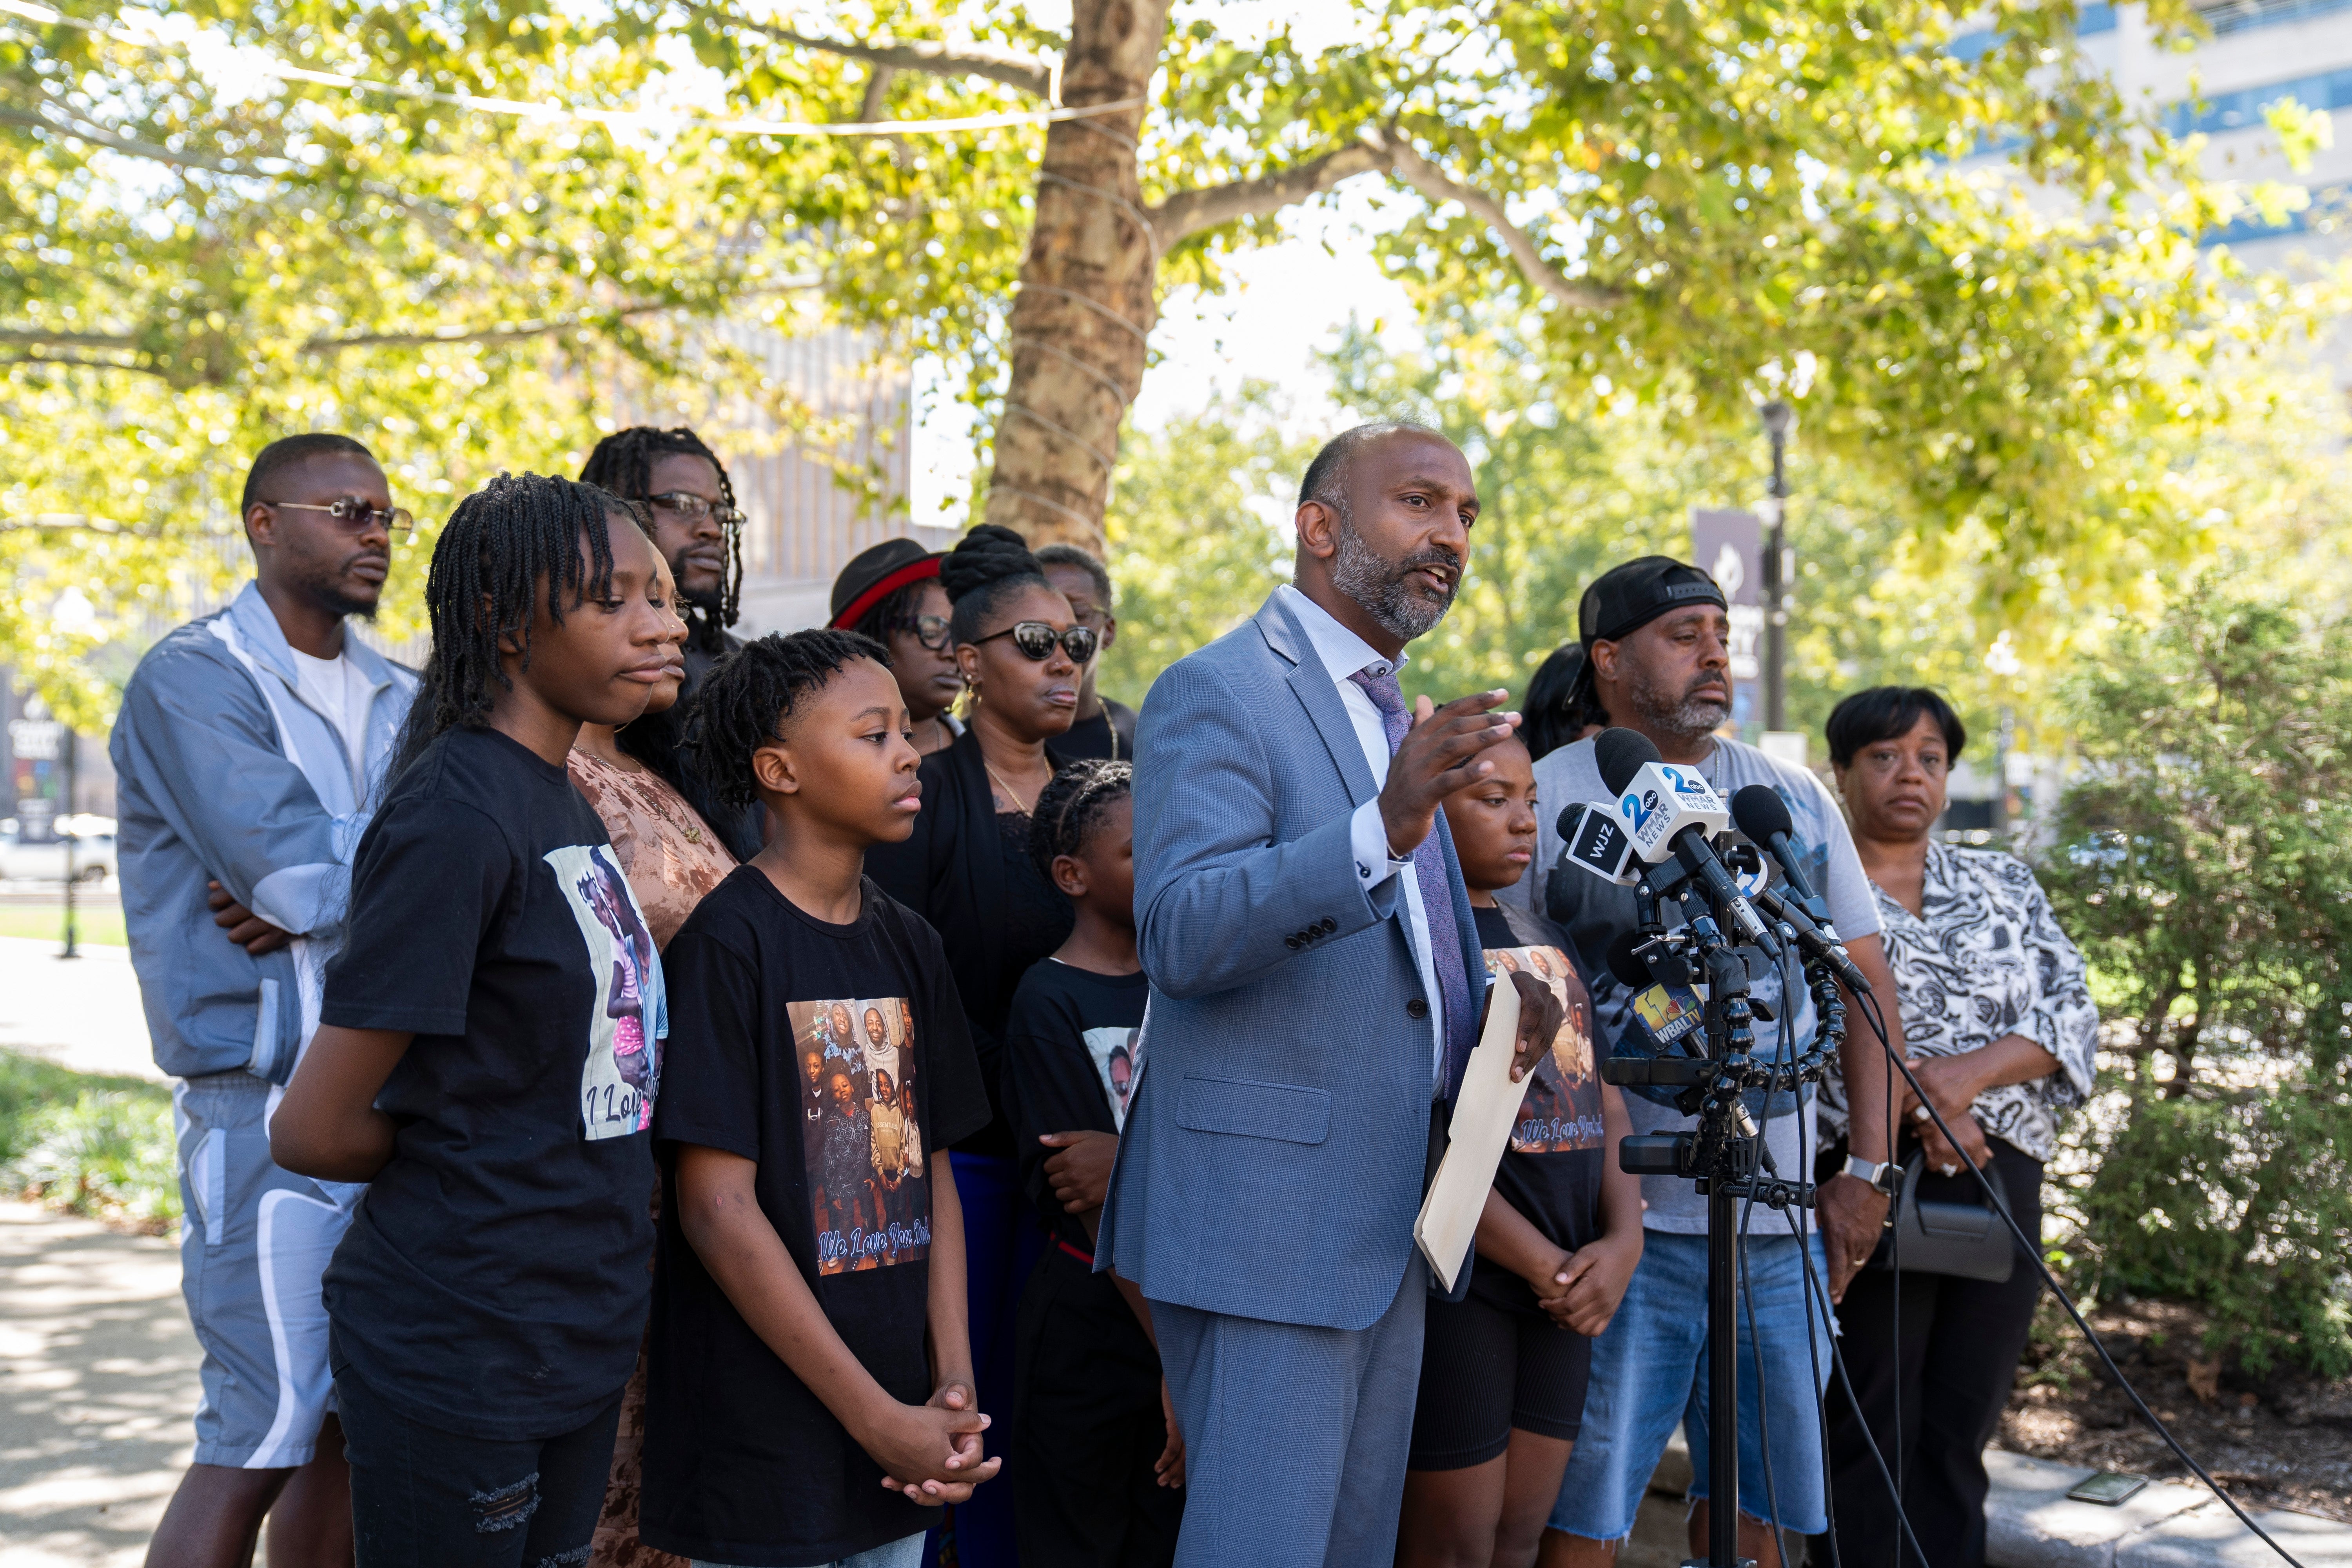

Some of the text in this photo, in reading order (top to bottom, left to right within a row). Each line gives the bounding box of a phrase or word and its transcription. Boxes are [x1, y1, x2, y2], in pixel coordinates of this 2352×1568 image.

[1662, 767, 1697, 793] 2
[1622, 792, 1657, 835] 2 abc
[1677, 794, 1716, 804] WMAR
[1637, 803, 1668, 842] WMAR
[1645, 814, 1670, 848] NEWS
[1590, 823, 1614, 857] WJZ
[1633, 983, 1671, 1033] 11
[586, 1085, 597, 1125] I
[604, 1082, 643, 1123] Love
[876, 1122, 898, 1130] ESSENTIALS
[1521, 1119, 1550, 1143] We
[1551, 1117, 1579, 1142] Love
[819, 1230, 847, 1261] We
[851, 1227, 887, 1258] Love
[888, 1222, 912, 1258] You
